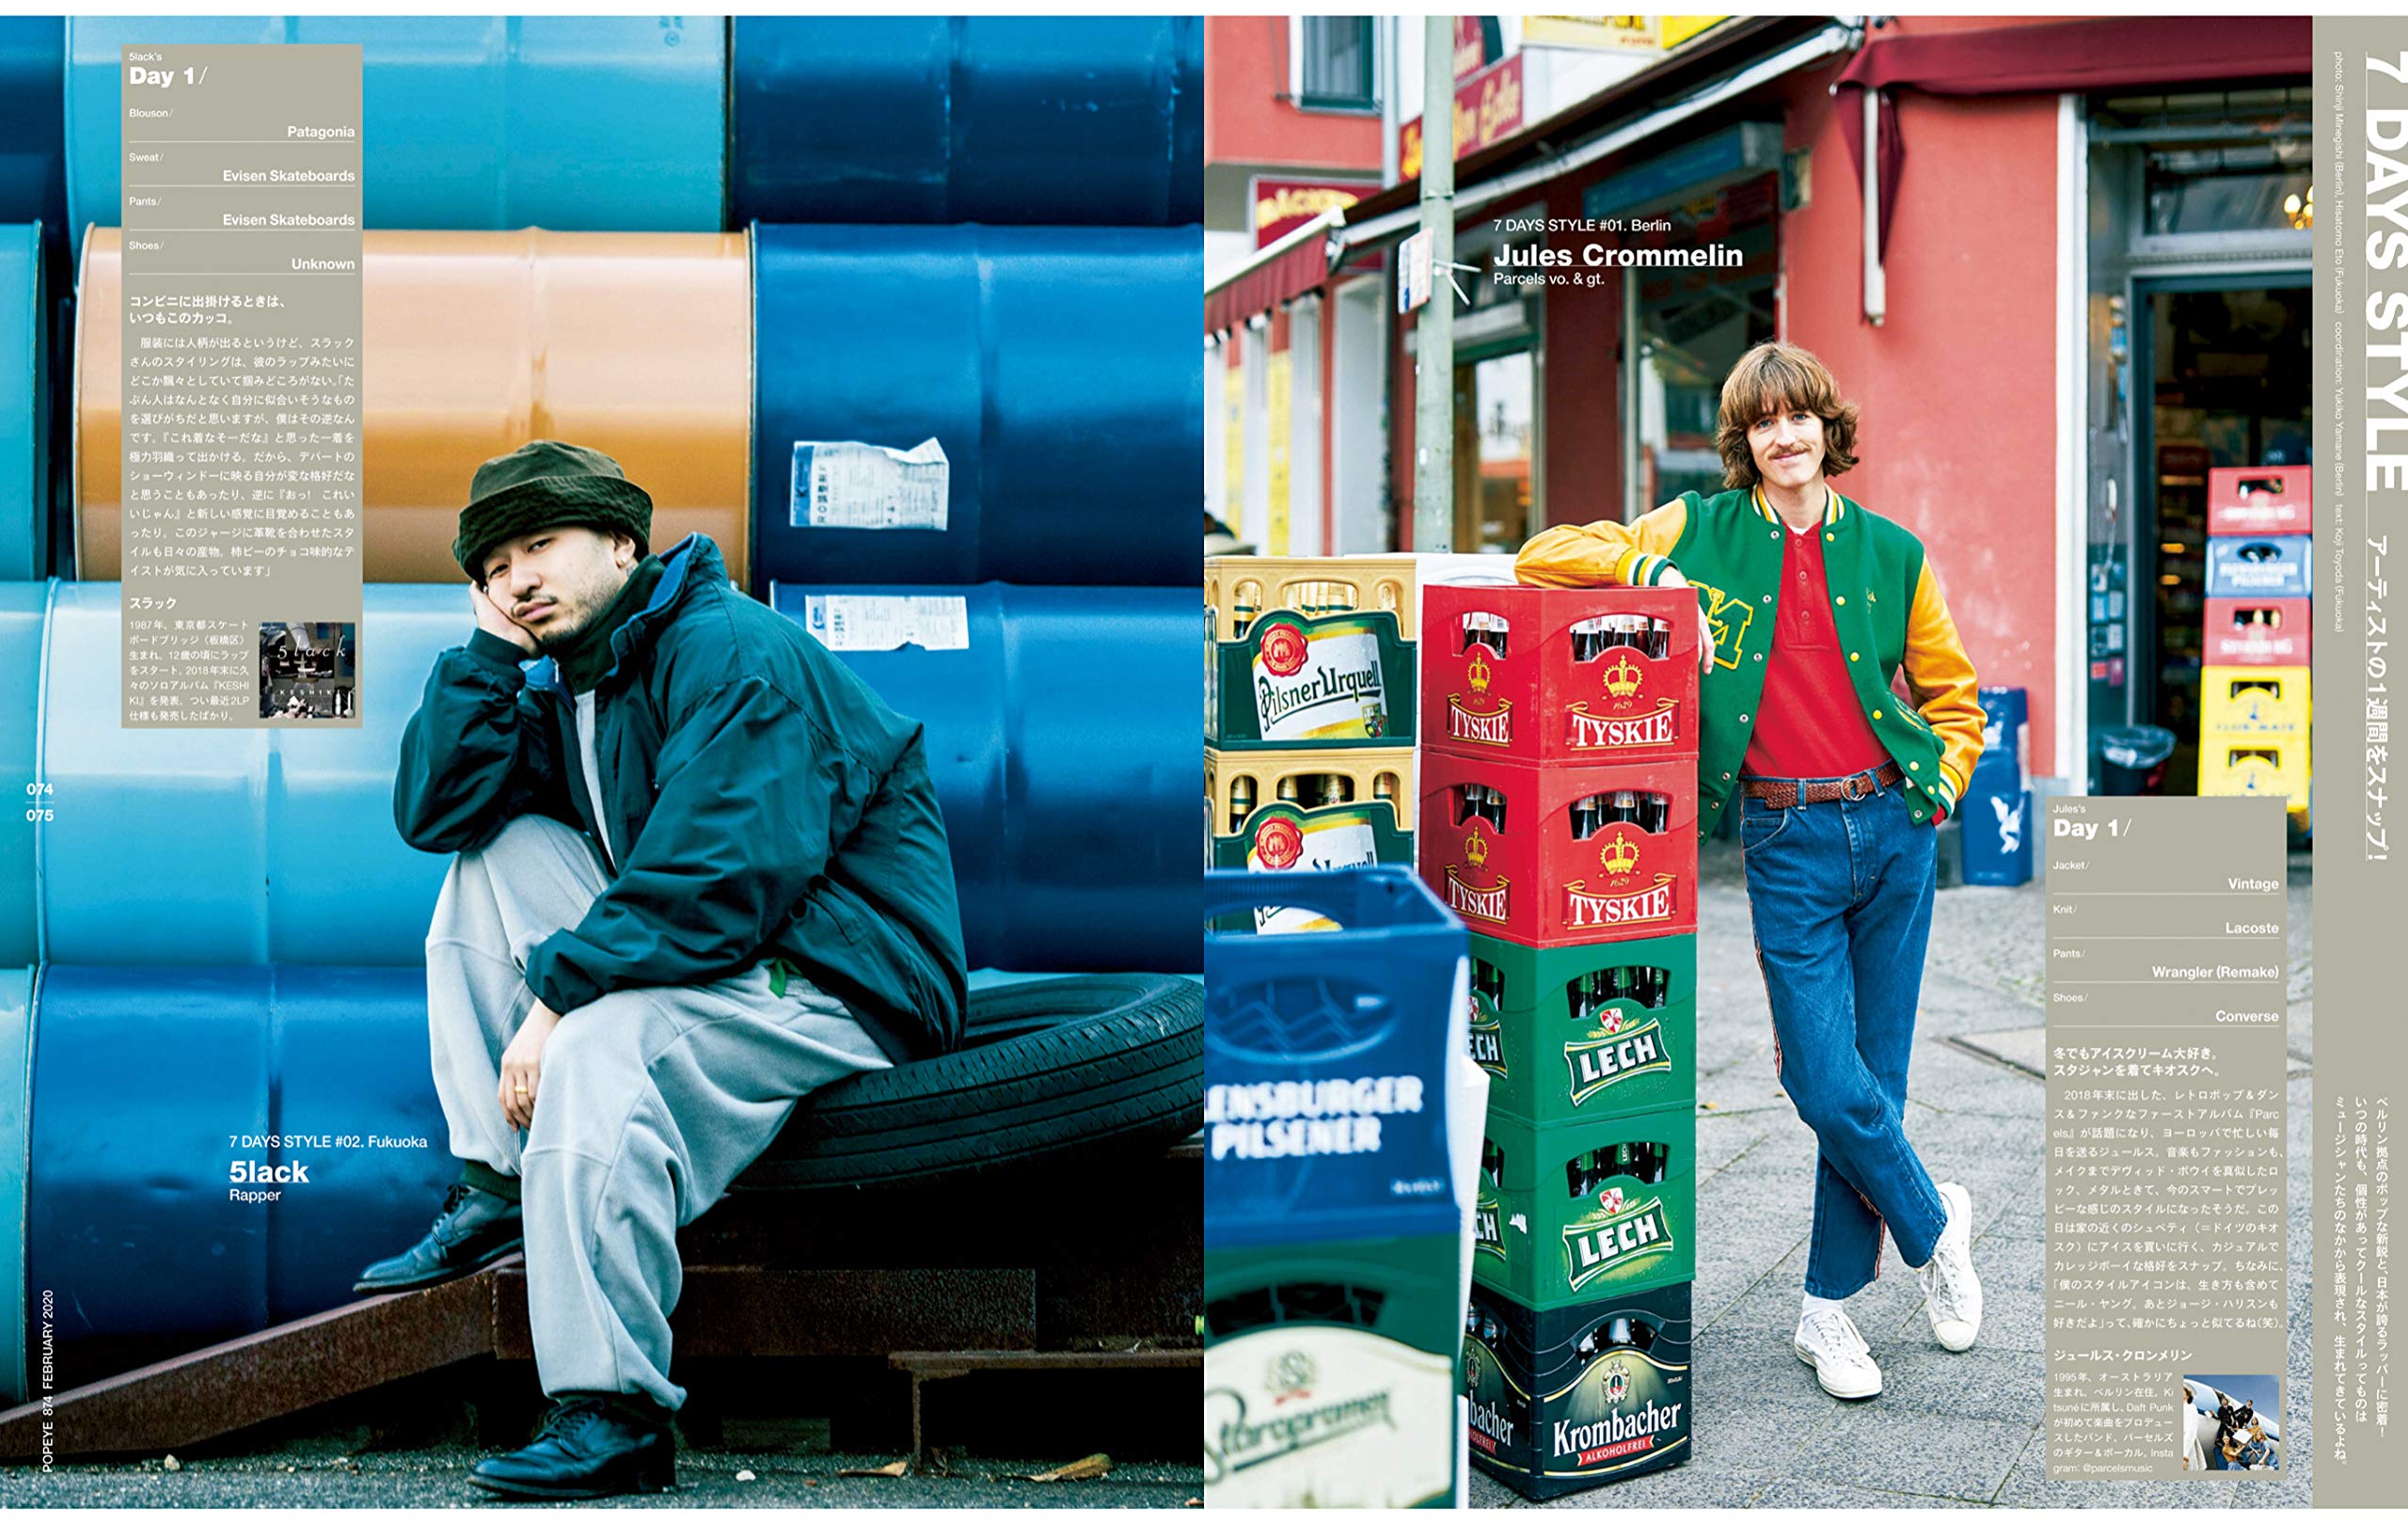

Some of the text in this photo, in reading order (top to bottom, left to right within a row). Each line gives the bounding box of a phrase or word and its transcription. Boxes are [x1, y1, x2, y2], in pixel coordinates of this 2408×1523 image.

[1258, 660, 1382, 732] Pilsner Urquell
[1451, 705, 1509, 743] TYSKIE
[1573, 710, 1672, 747] TYSKIE
[1449, 876, 1506, 921] TYSKIE
[1570, 885, 1670, 926] TYSKIE
[1578, 1035, 1657, 1083] LECH
[1204, 1075, 1423, 1122] ENSBURGER
[1212, 1116, 1382, 1160] PILSENER
[1578, 1213, 1659, 1267] LECH
[1553, 1399, 1682, 1457] Krombacher
[1586, 1441, 1646, 1463] ALKOHOLFREI
